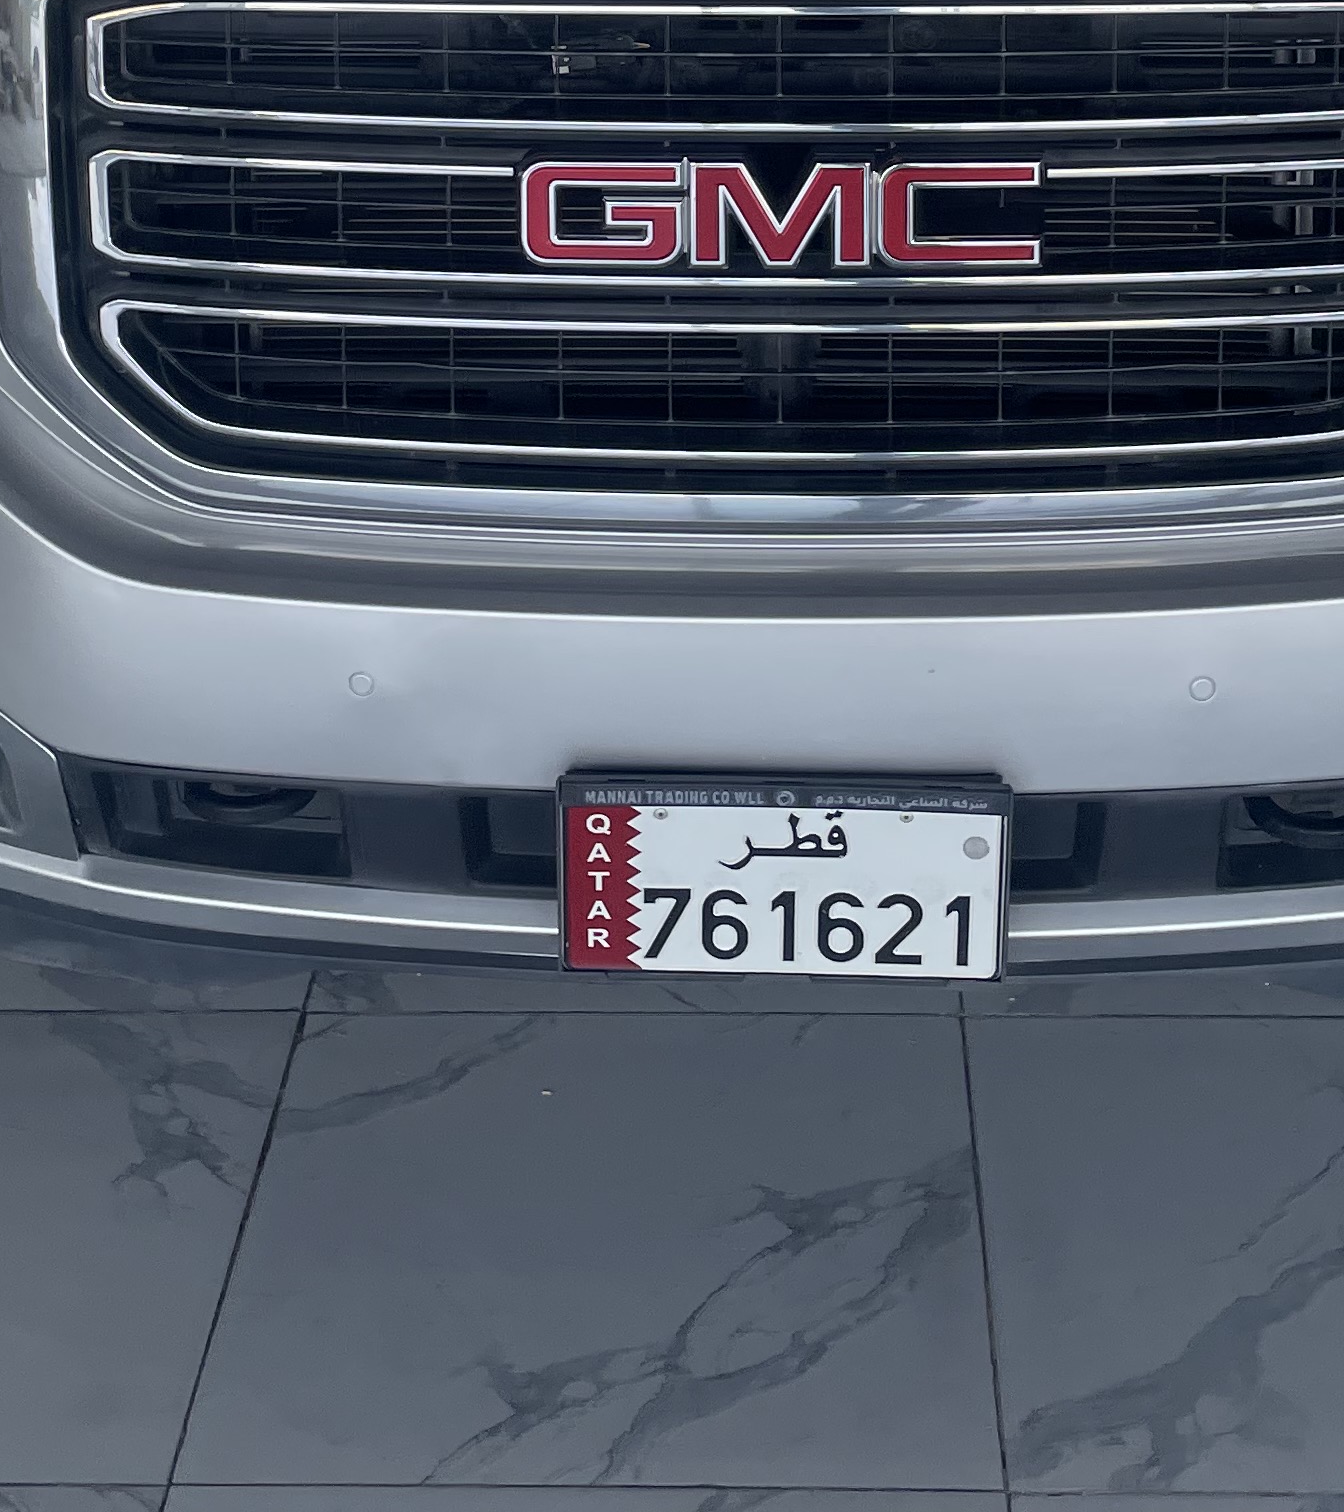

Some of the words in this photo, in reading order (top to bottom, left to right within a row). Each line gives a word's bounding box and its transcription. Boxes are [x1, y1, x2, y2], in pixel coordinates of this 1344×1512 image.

[520, 159, 1042, 268] GMC
[585, 790, 642, 805] MANNAI
[646, 790, 707, 805] TRADING
[718, 809, 849, 871] قطر
[585, 813, 612, 949] QATAR
[643, 887, 972, 967] 761621
